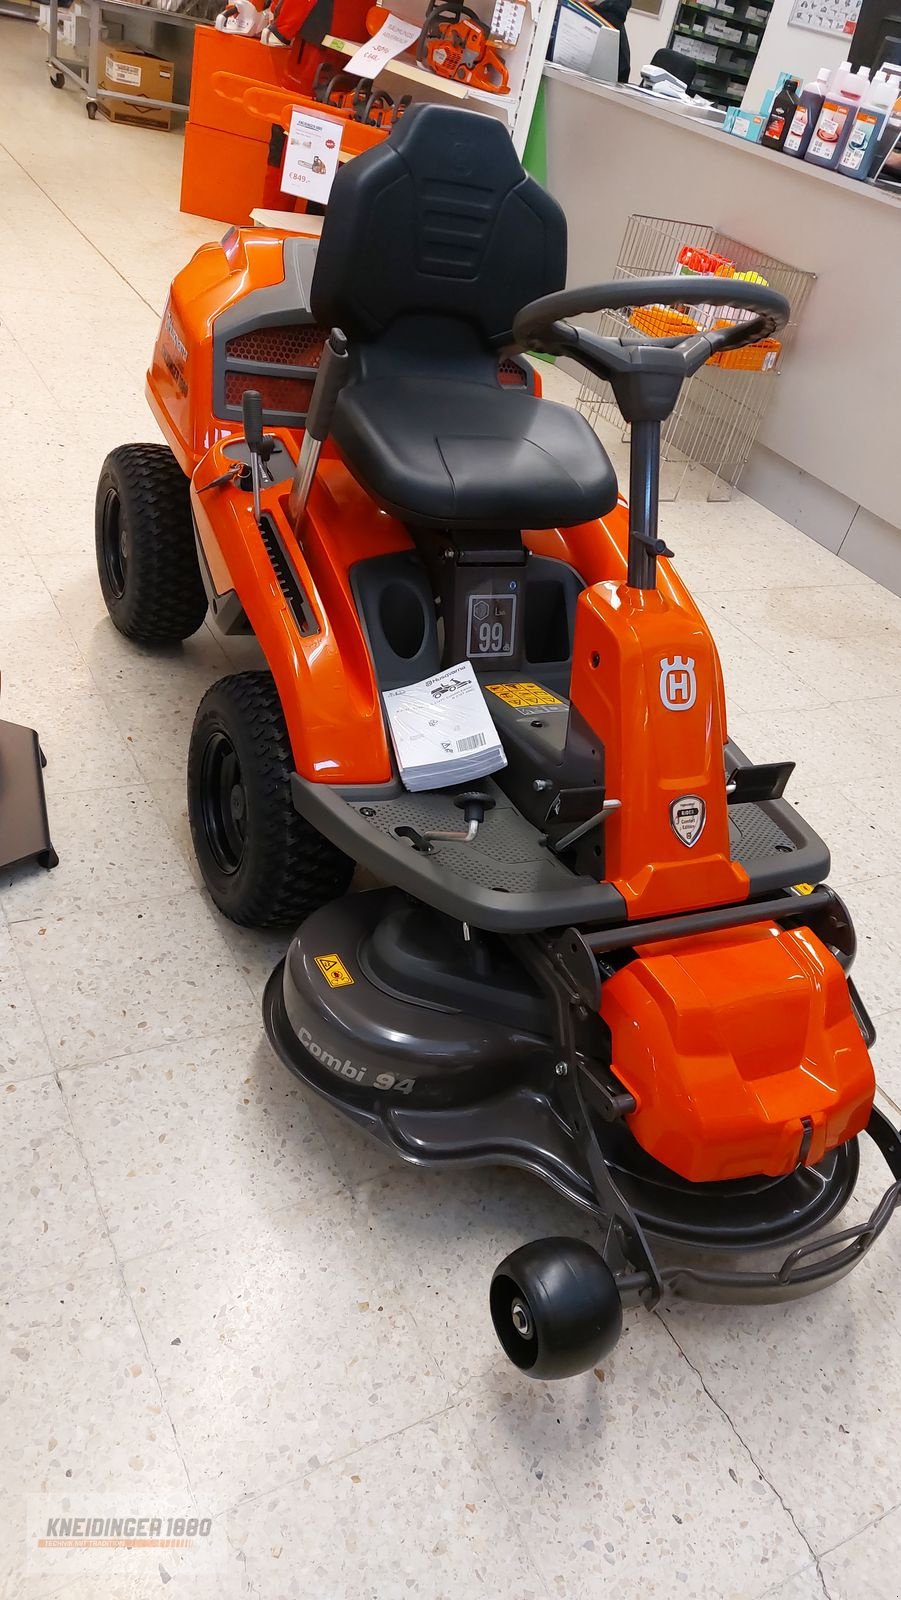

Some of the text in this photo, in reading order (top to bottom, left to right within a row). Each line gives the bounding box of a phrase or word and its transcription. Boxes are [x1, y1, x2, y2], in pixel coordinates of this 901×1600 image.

[479, 622, 503, 652] 99
[432, 665, 467, 684] Husqvarna
[298, 1027, 417, 1094] Combi 94
